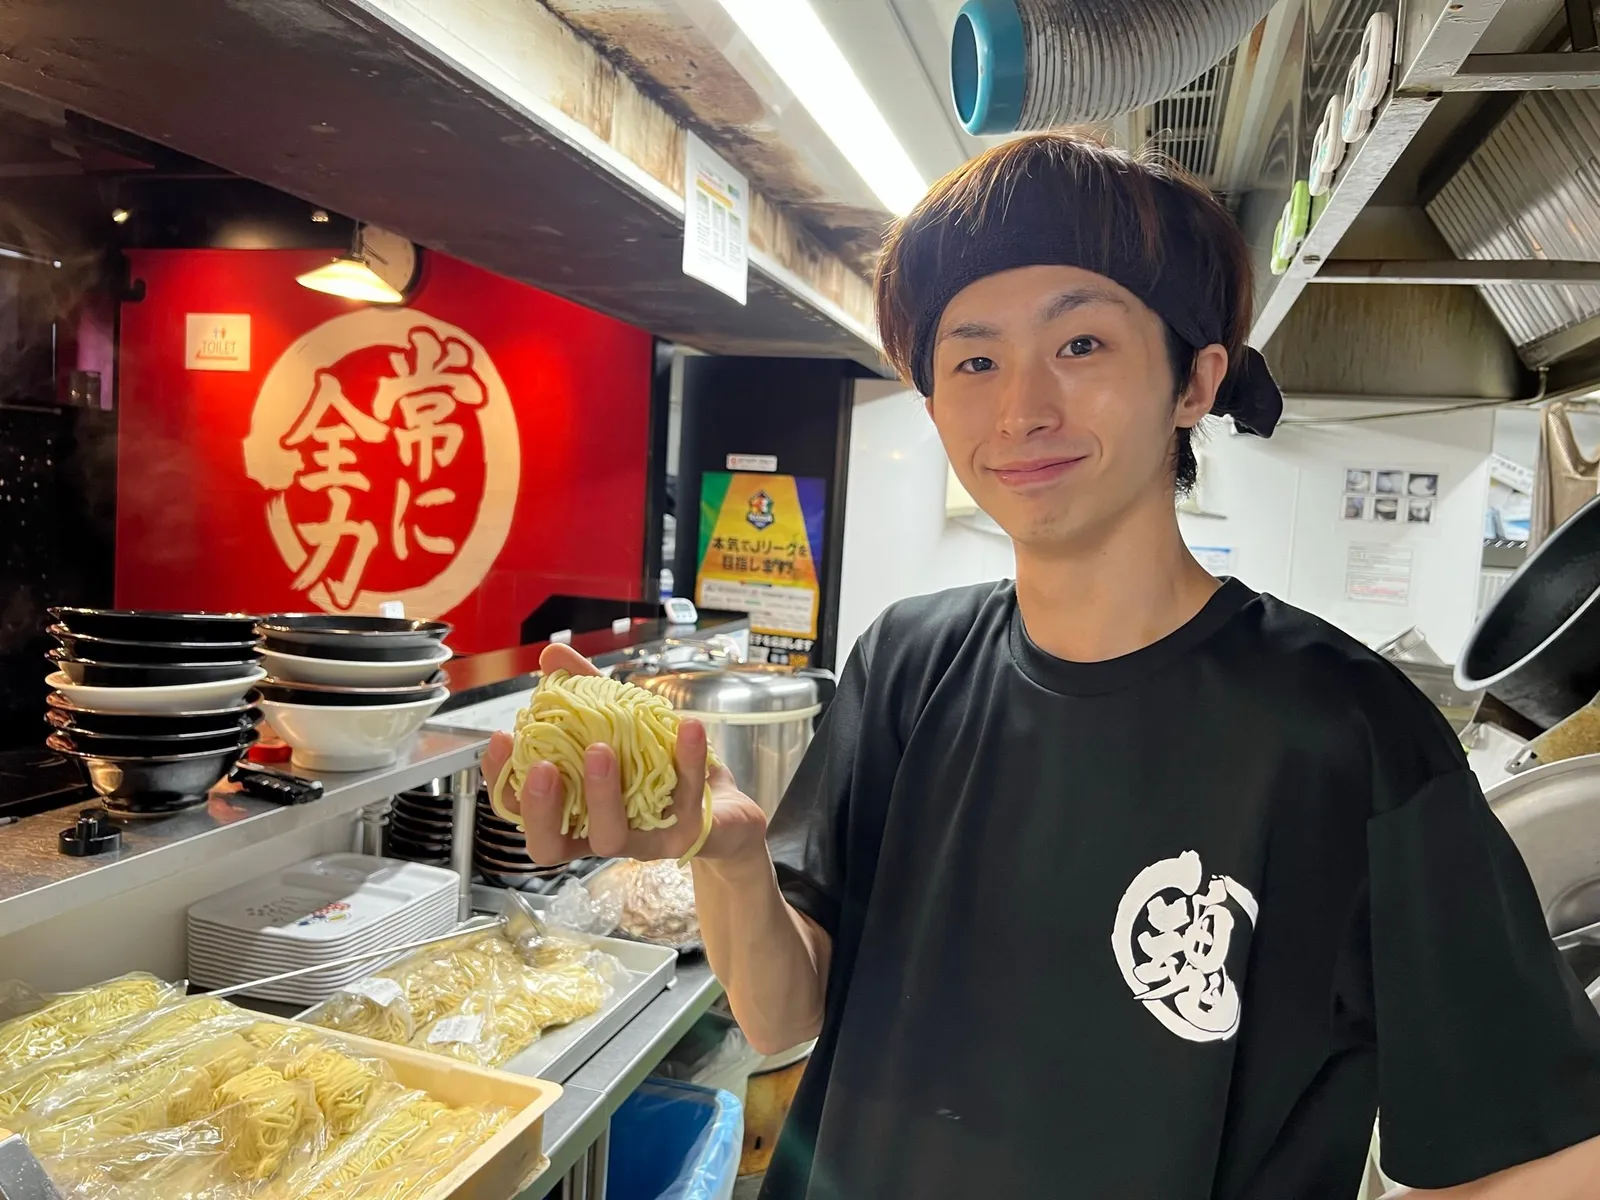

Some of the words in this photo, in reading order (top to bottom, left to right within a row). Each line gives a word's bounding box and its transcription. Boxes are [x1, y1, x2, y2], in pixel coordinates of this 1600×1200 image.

[202, 340, 236, 355] TOILET
[283, 371, 391, 606] 全力
[372, 328, 484, 561] 常に
[713, 536, 808, 558] 本気でJリーグを
